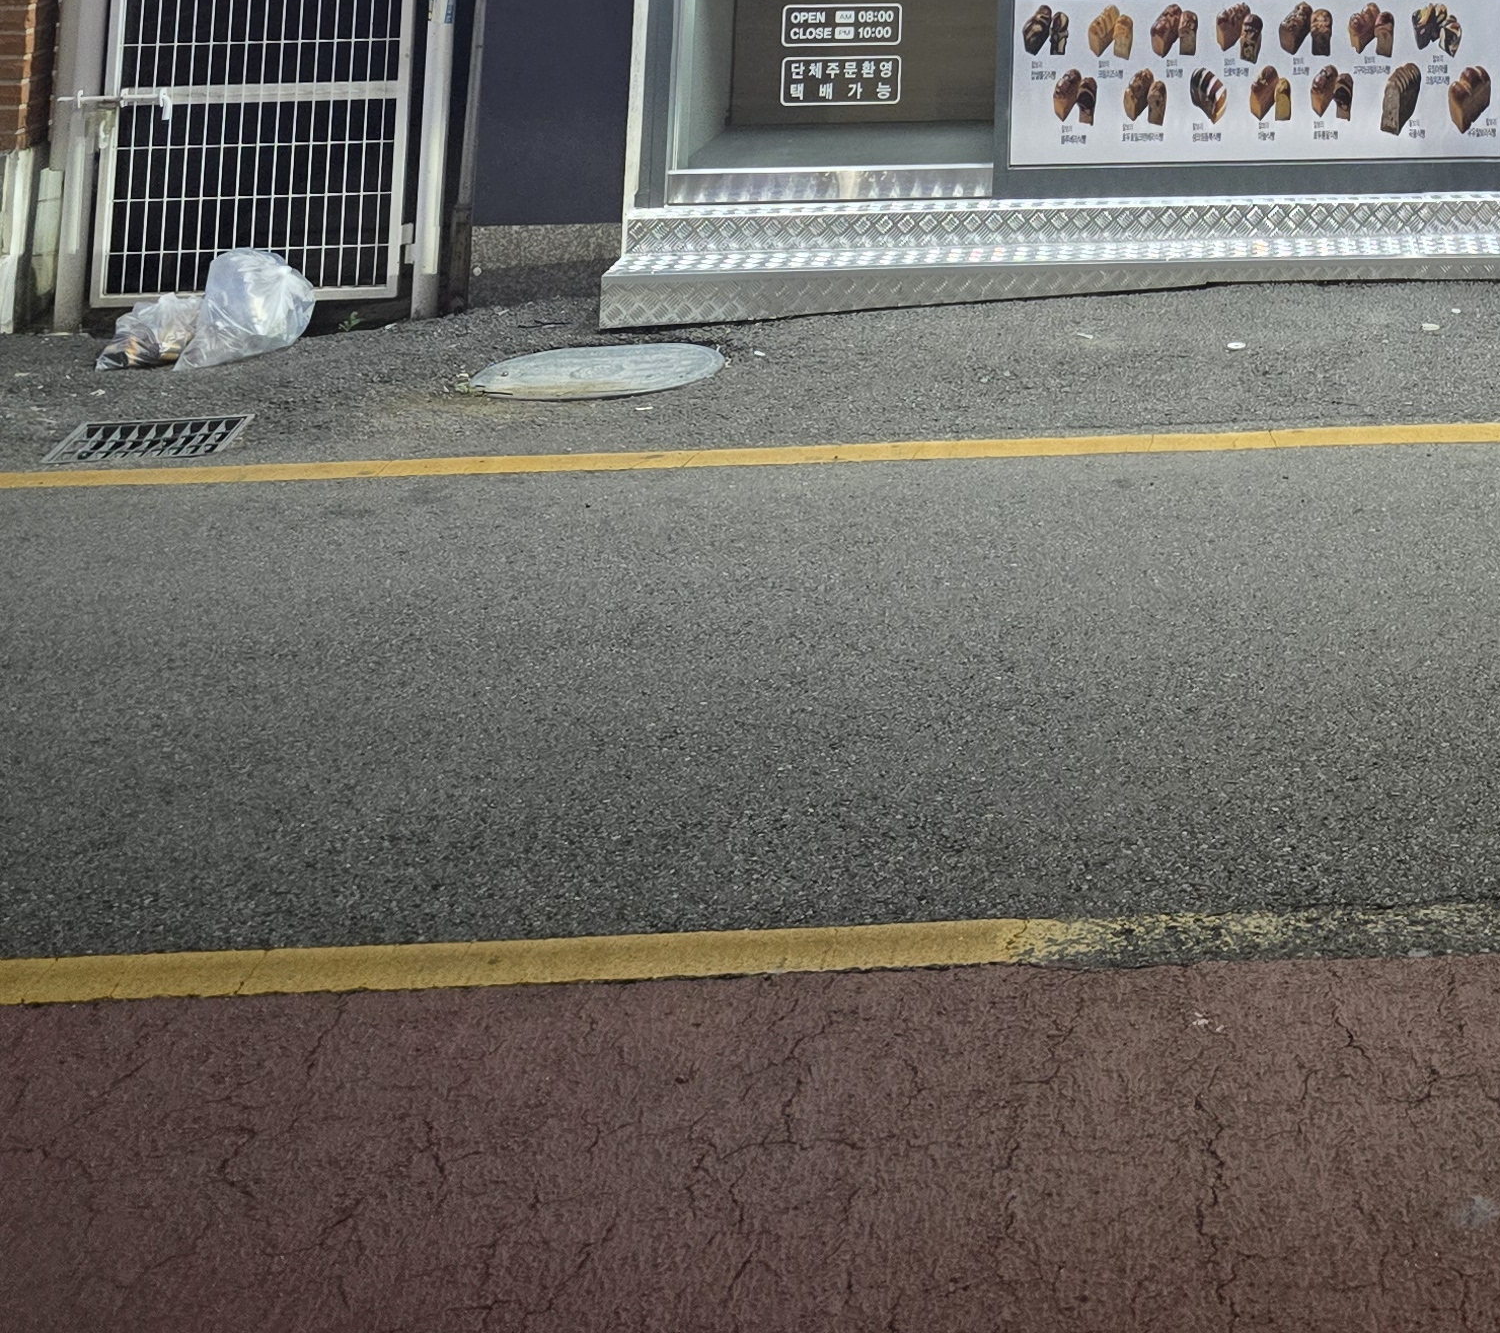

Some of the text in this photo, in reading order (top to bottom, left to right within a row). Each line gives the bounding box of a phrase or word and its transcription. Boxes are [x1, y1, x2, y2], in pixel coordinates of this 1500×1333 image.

[790, 11, 826, 23] OPEN
[858, 10, 894, 22] 08:00
[790, 27, 832, 39] CLOSE
[858, 26, 892, 38] 10:00
